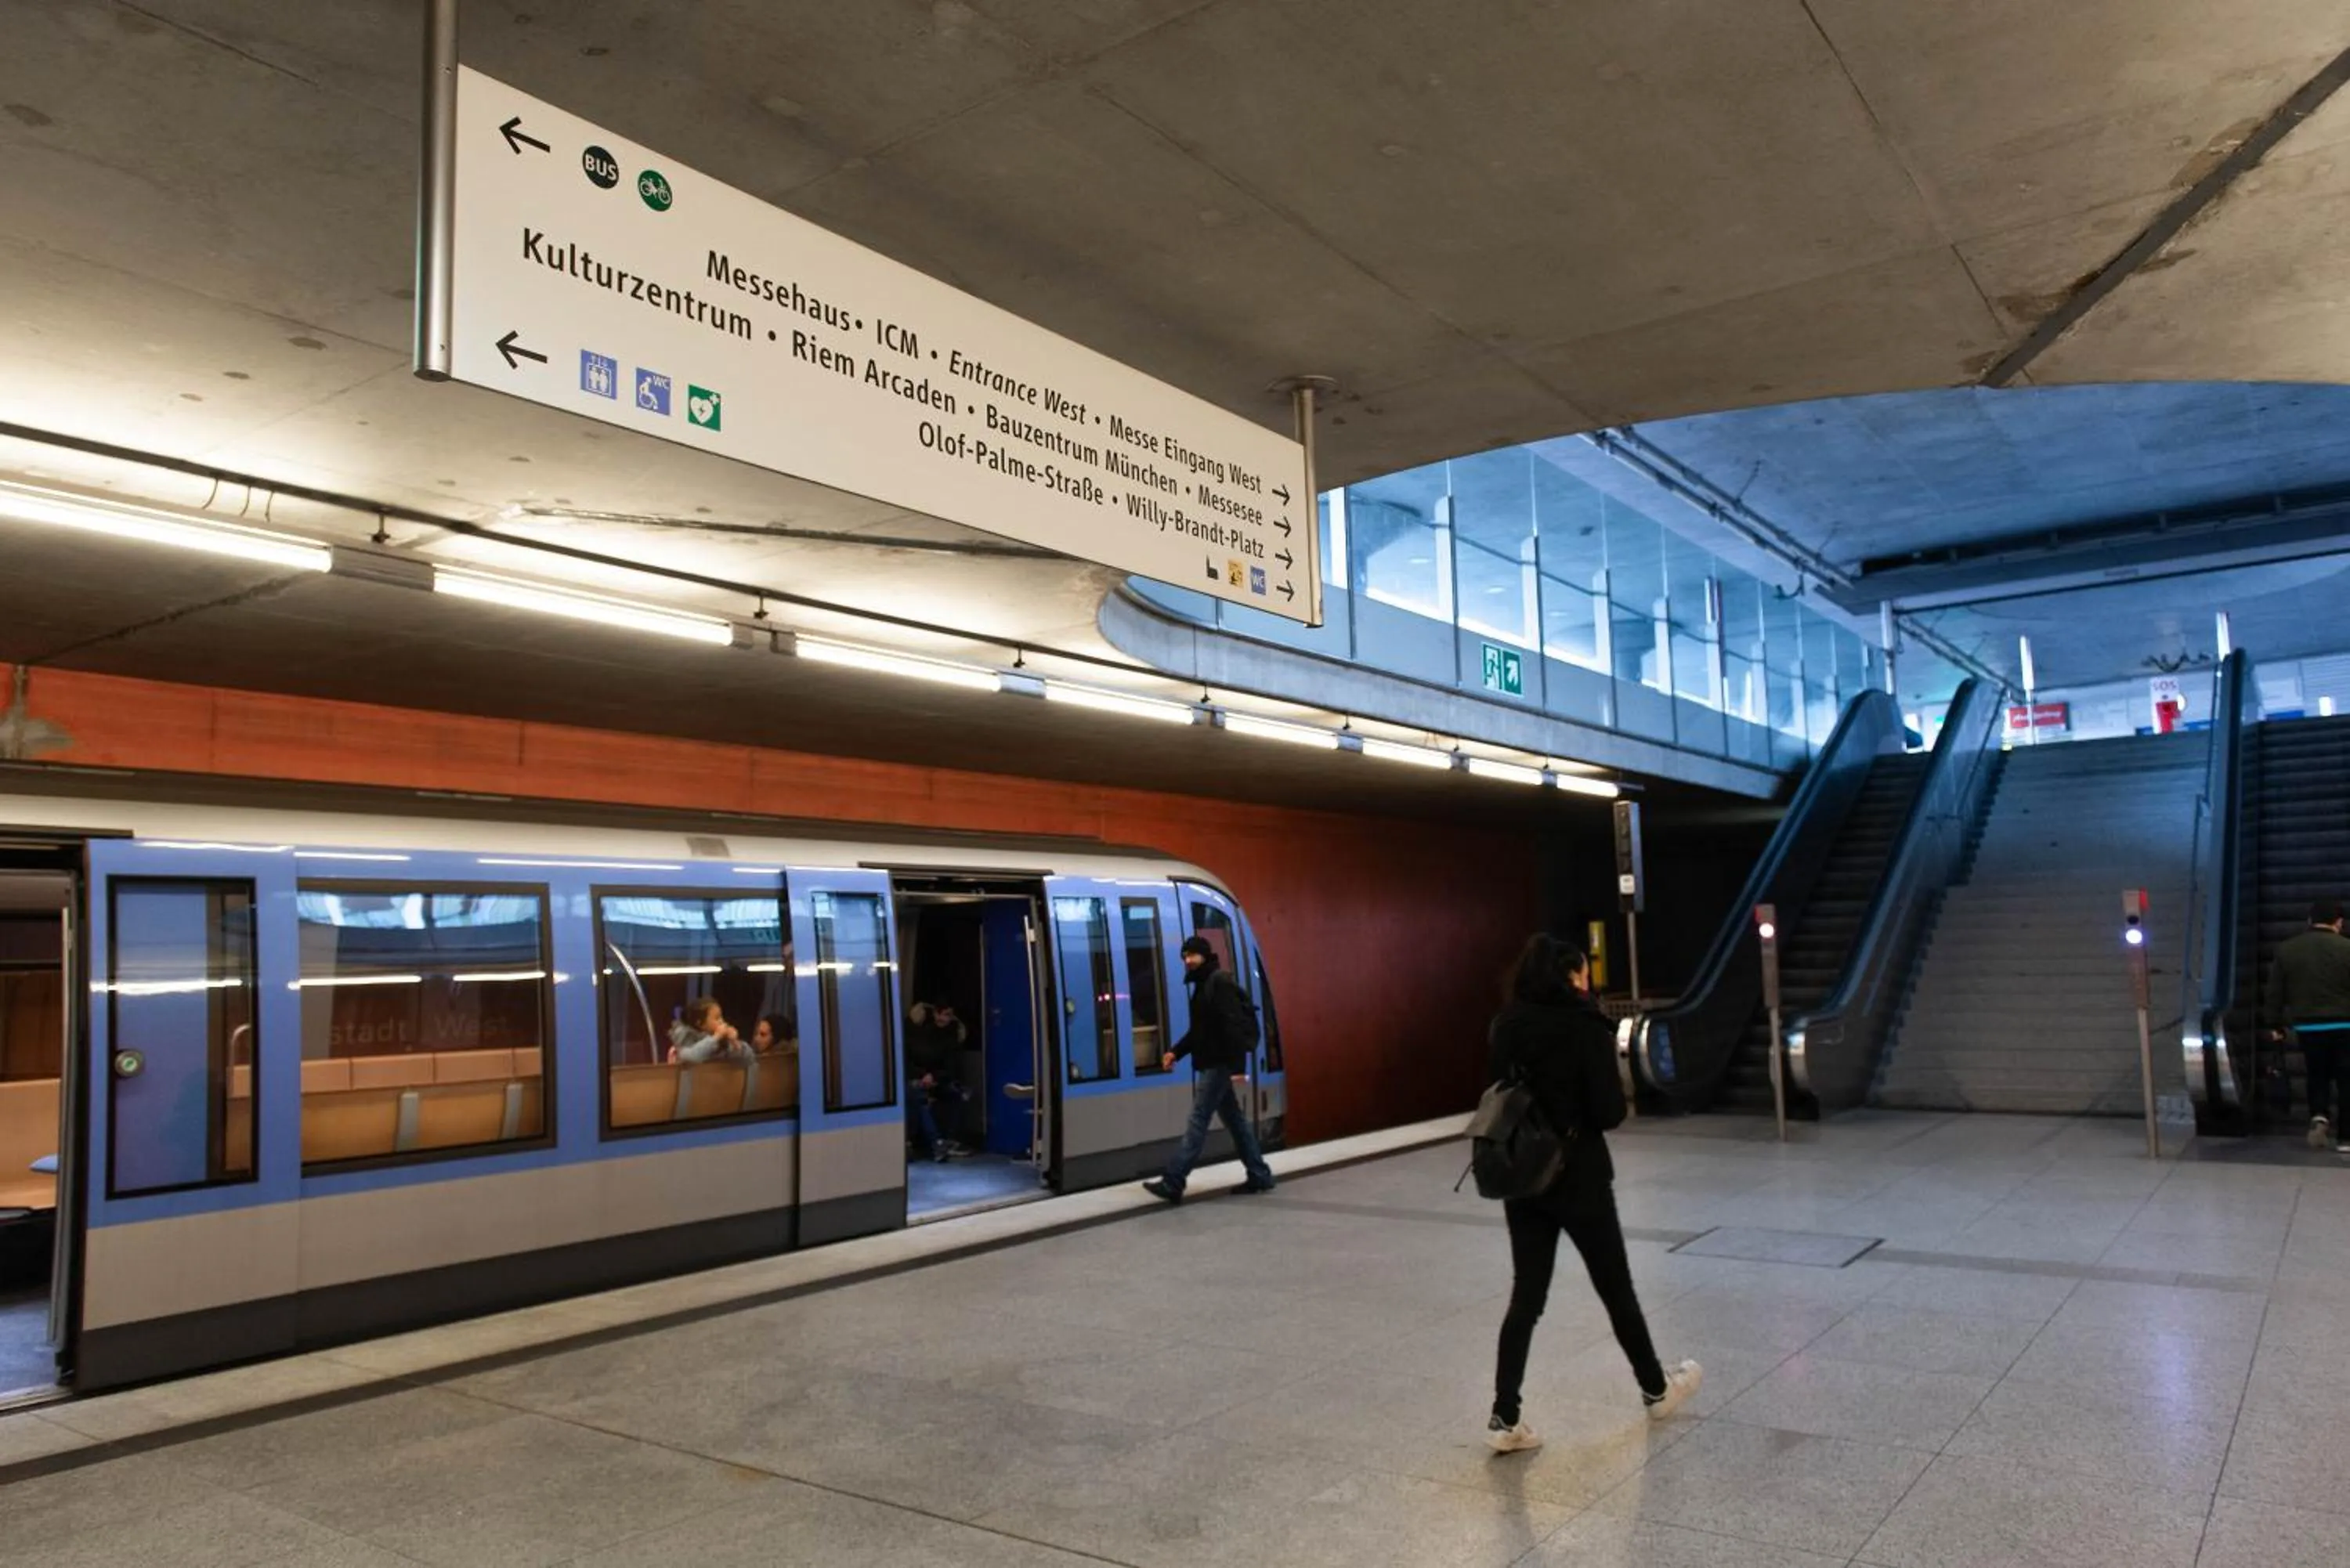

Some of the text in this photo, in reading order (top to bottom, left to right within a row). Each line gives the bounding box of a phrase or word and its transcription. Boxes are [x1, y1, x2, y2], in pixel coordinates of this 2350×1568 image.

[585, 154, 617, 181] BUS
[522, 226, 1263, 527] Kulturzentrum Riem Arcaden Bauzentrum München Messesee
[653, 375, 671, 389] WC
[707, 250, 1262, 494] Messehaus ICM Entrance West Messe Eingang West
[918, 421, 1264, 559] Olof-Palme-Straße Willy-Brandt-Platz
[1253, 571, 1265, 587] WC
[2153, 680, 2177, 692] SOS
